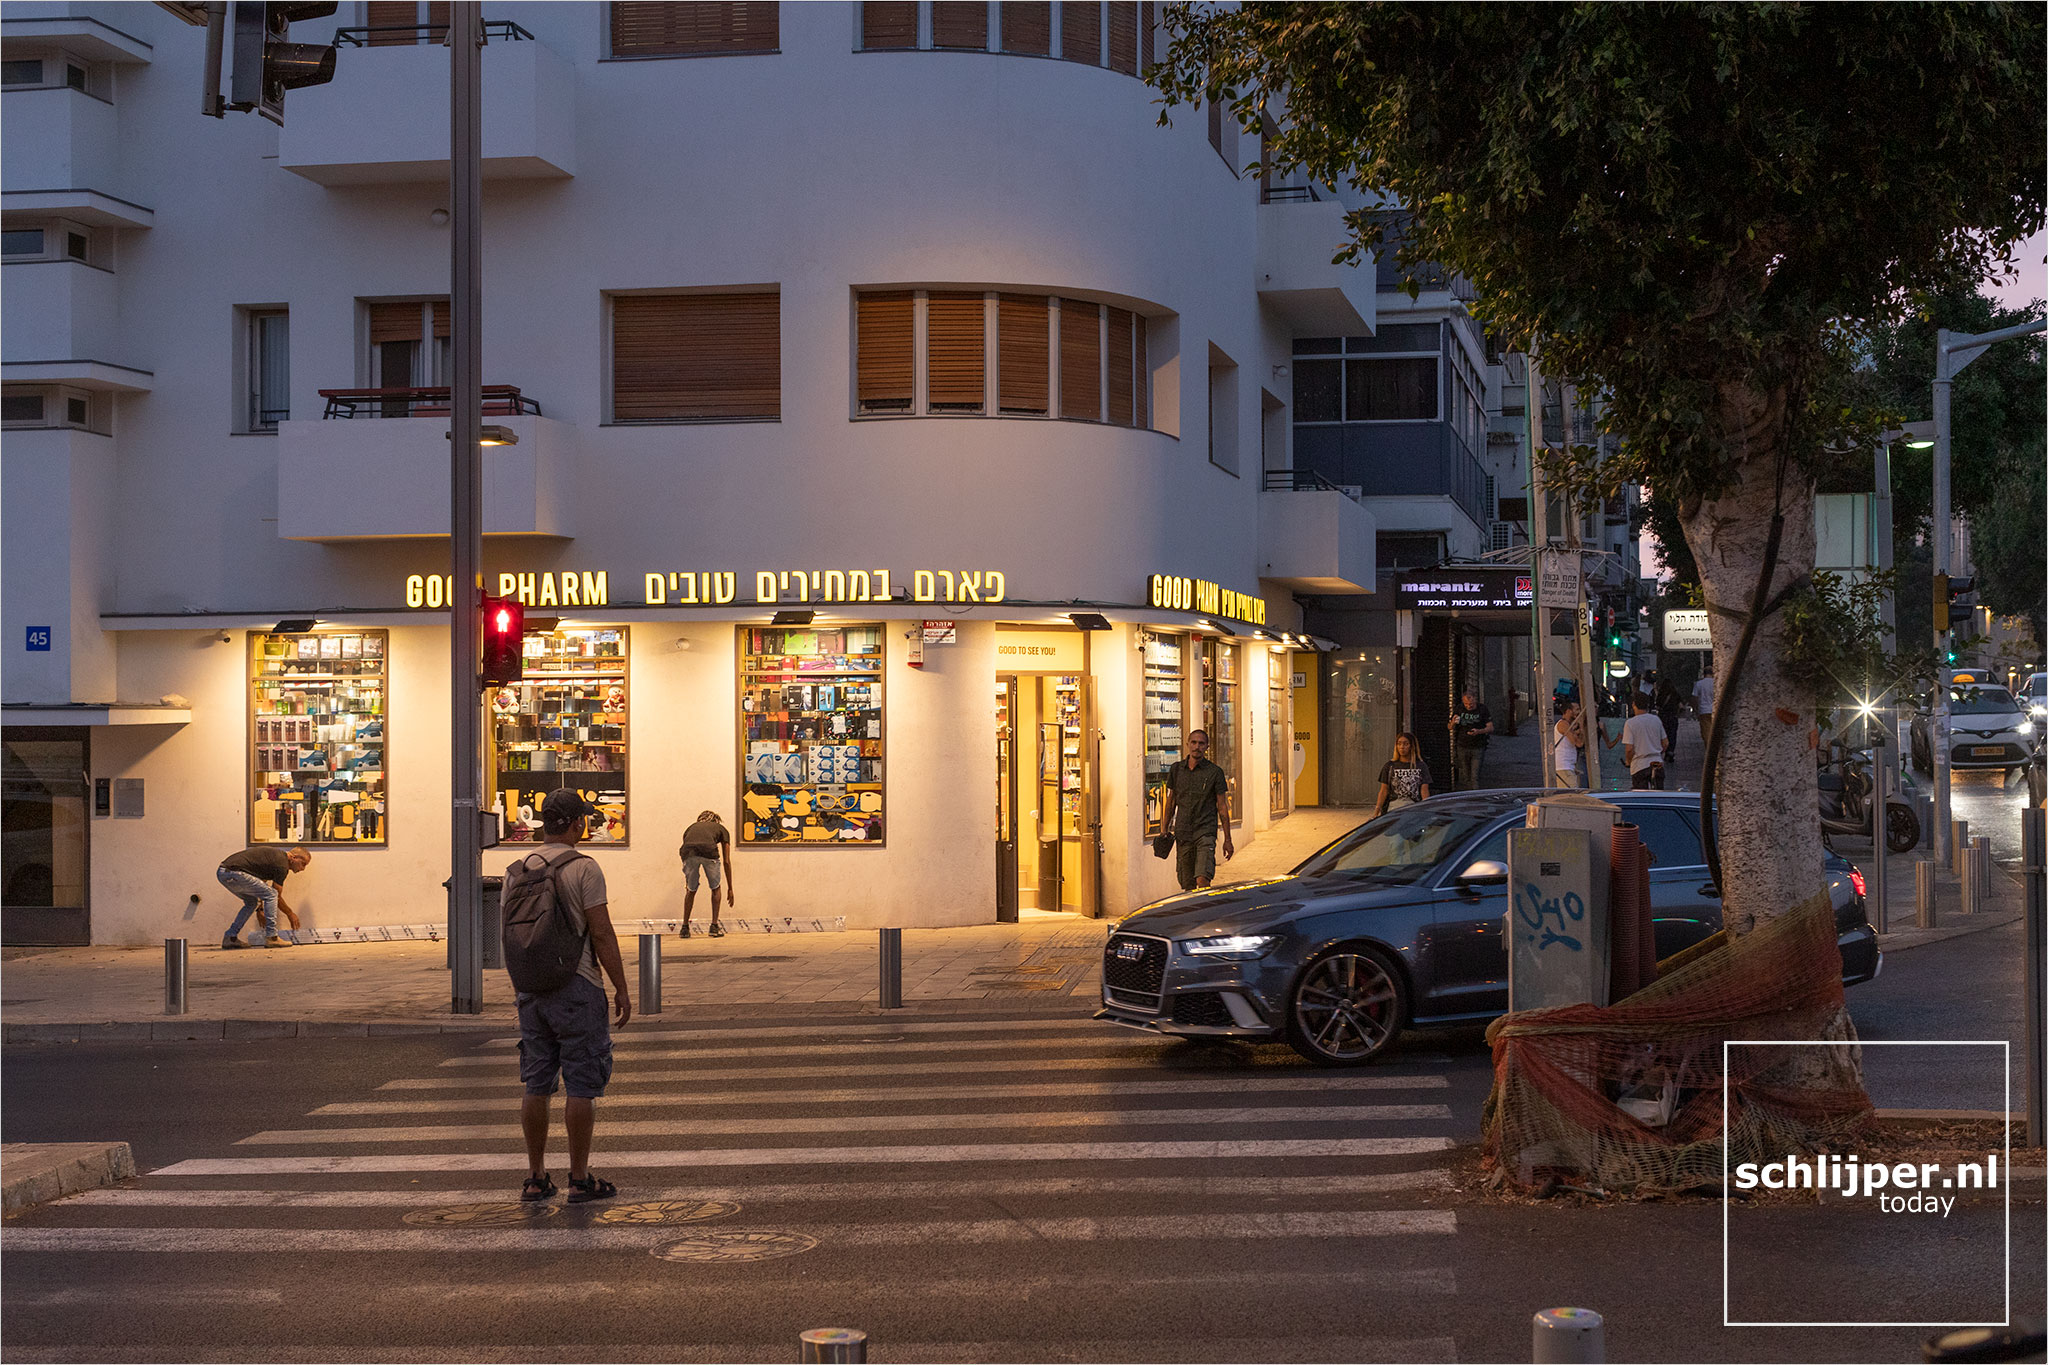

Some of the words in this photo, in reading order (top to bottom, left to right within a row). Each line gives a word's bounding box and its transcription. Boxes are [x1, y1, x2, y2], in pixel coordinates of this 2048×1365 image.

[406, 574, 453, 608] GO
[499, 571, 607, 606] PHARM
[645, 571, 736, 604] טובים
[756, 569, 892, 603] במחירים
[914, 570, 1005, 603] פארם
[1152, 573, 1192, 610] GOOD
[1401, 582, 1480, 592] marantz
[1541, 588, 1557, 596] Danger
[29, 632, 48, 645] 45
[998, 646, 1017, 655] GOOD
[1018, 646, 1026, 655] TO
[1027, 646, 1039, 655] SEE
[1040, 647, 1056, 656] YOU!
